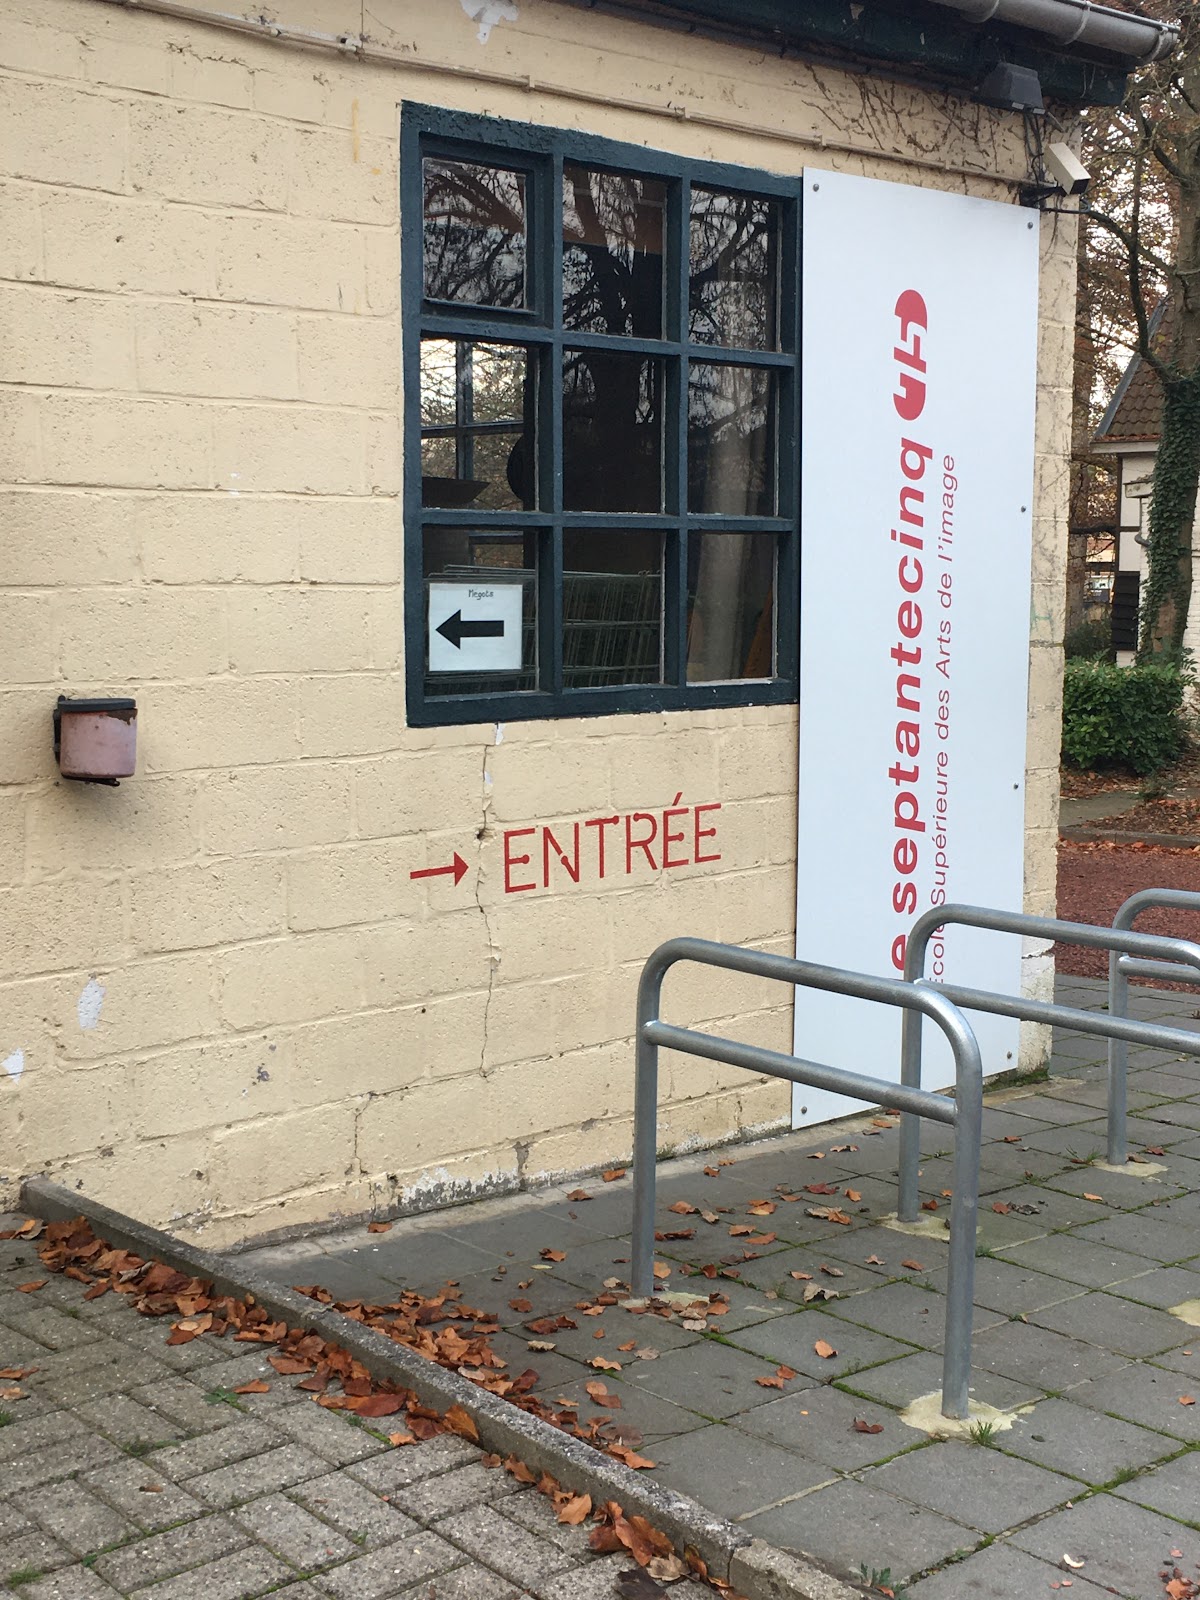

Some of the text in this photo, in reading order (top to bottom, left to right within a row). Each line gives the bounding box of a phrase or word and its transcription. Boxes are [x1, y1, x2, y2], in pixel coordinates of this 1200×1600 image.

[938, 454, 958, 562] l'image
[938, 573, 953, 609] de
[889, 437, 933, 915] septantecinq
[936, 620, 951, 679] Arts
[935, 689, 950, 741] des
[502, 791, 723, 895] ENTRÉE
[931, 751, 949, 906] Supérieure
